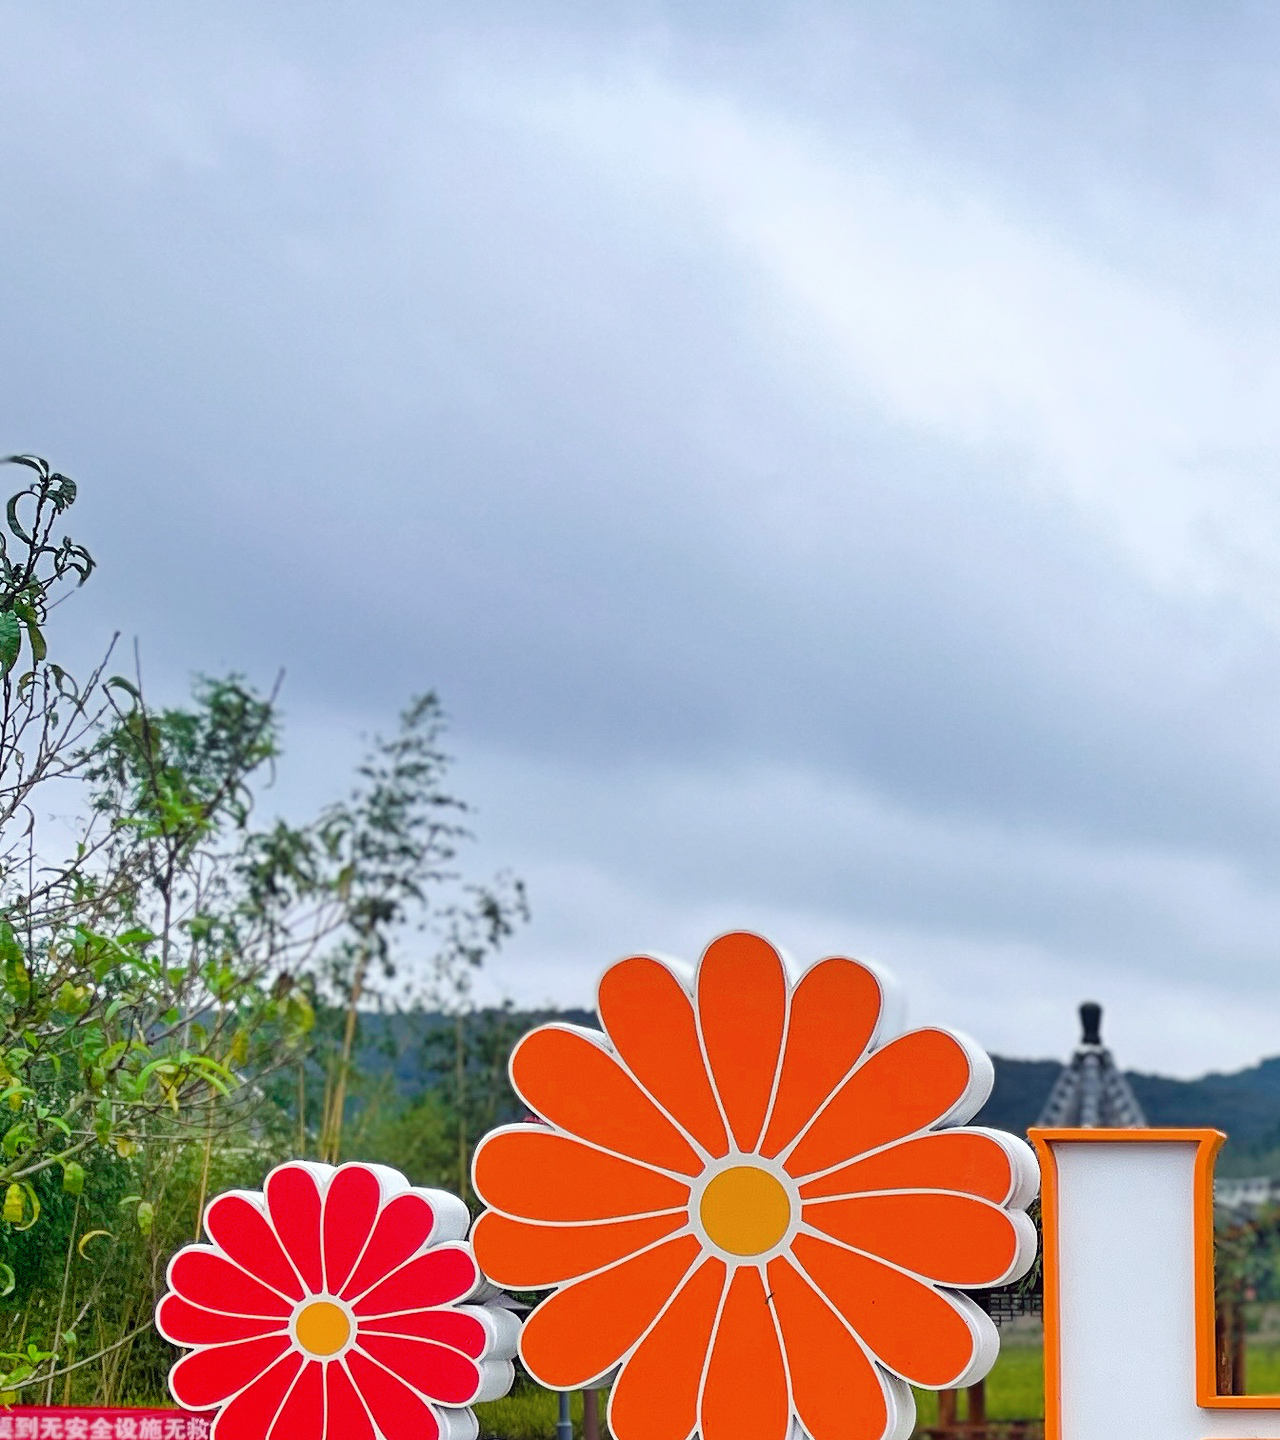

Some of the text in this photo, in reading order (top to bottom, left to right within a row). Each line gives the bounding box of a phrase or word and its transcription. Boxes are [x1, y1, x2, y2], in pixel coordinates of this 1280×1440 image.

[0, 1416, 212, 1440] 要到无安全设施无救
